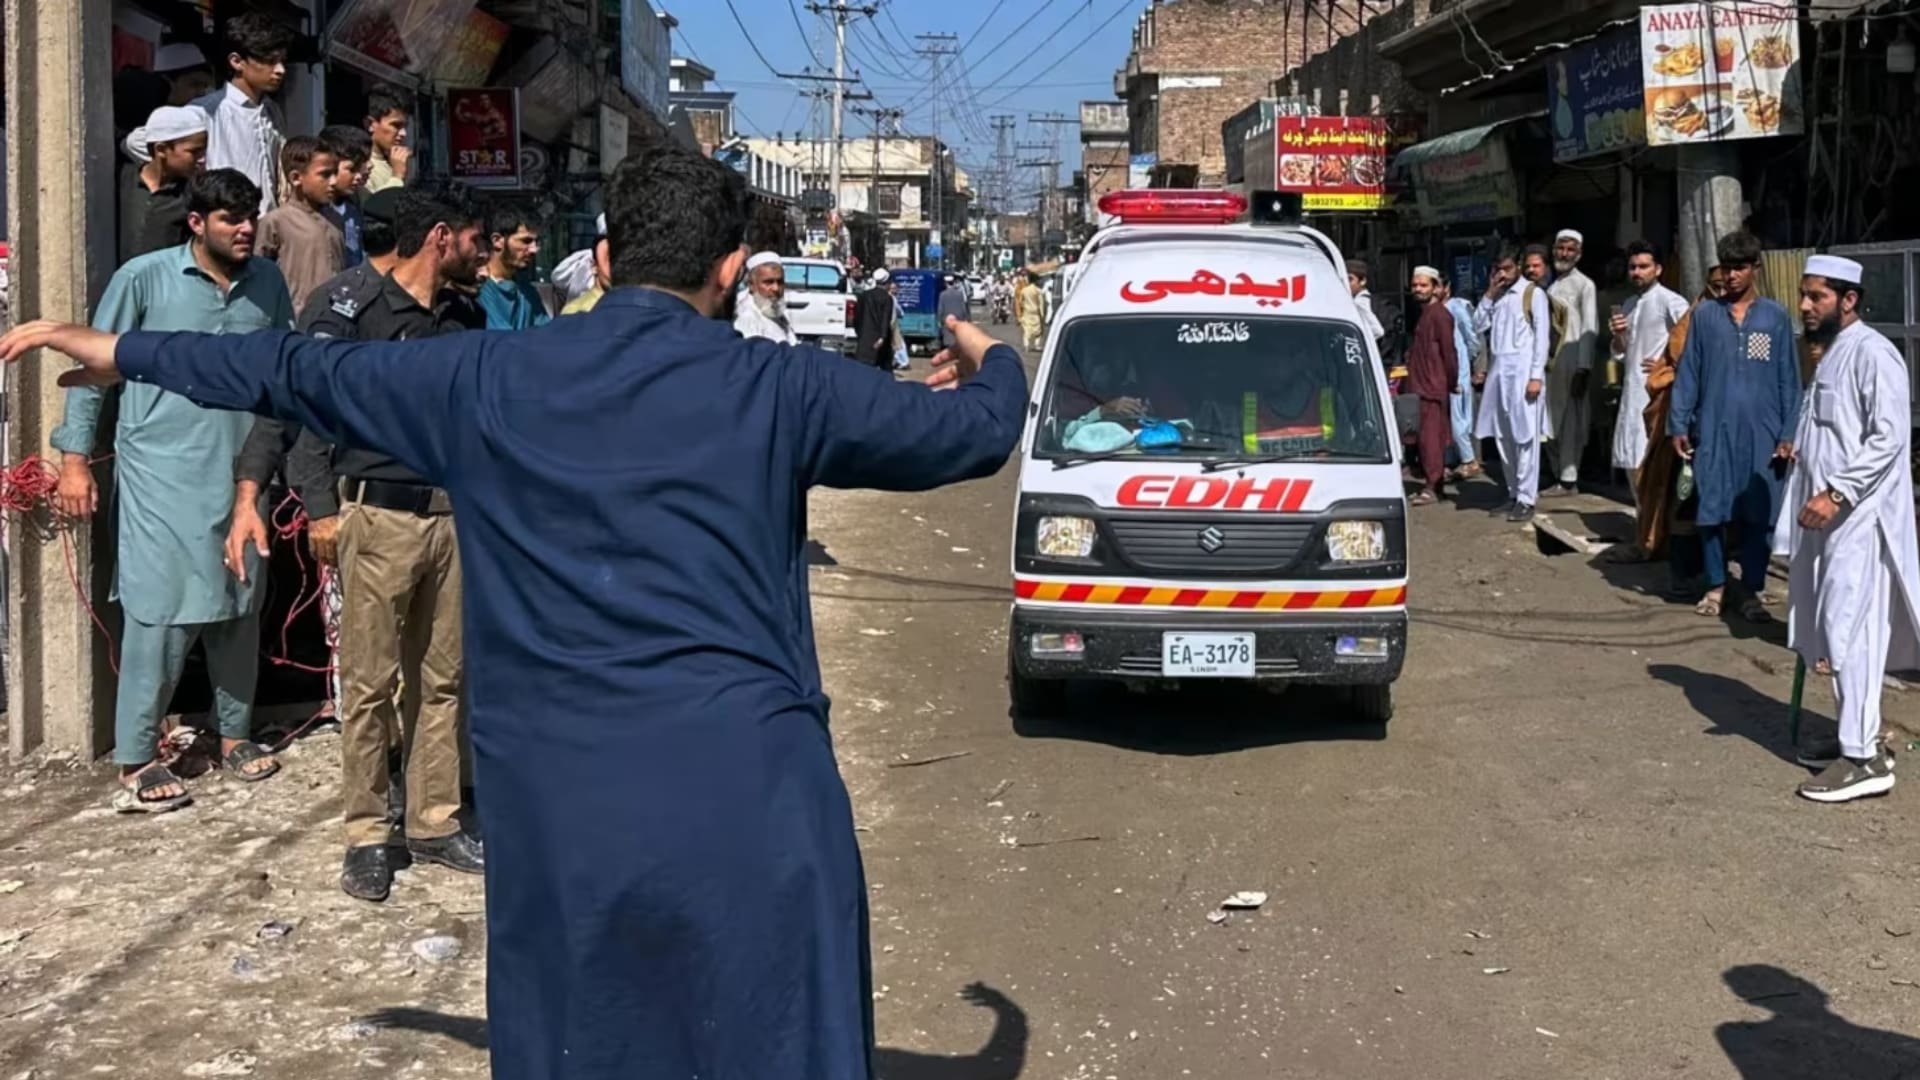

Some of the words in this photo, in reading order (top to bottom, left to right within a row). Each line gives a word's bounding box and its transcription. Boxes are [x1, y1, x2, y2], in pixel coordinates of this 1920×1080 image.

[1647, 9, 1705, 32] ANAYA
[1120, 268, 1306, 307] ایدھی
[1116, 474, 1313, 512] EDHI
[1170, 644, 1250, 665] EA-3178
